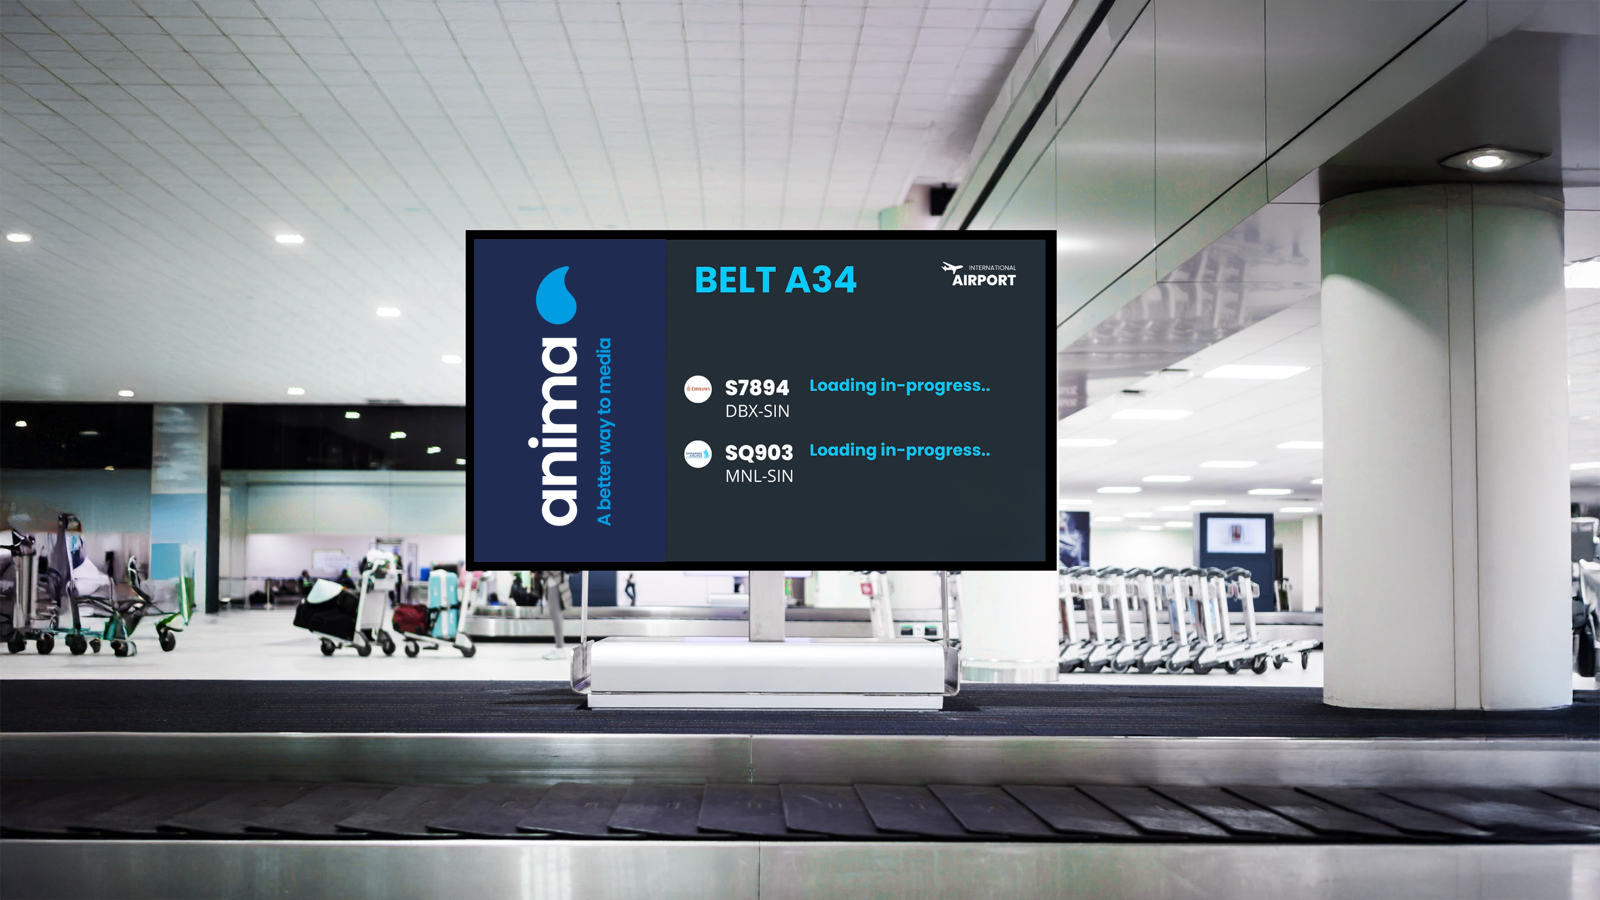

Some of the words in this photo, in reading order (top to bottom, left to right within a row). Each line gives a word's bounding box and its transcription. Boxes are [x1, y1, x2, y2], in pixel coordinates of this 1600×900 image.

[695, 266, 776, 294] BELT
[784, 265, 858, 294] A34
[952, 274, 1017, 286] AIRPORT
[595, 337, 612, 394] media
[724, 378, 790, 397] S7894
[809, 377, 877, 397] Loading
[880, 377, 991, 397] in-progress..
[597, 396, 612, 416] to
[725, 403, 790, 418] DBX-SIN
[527, 337, 578, 527] anima
[599, 417, 616, 456] way
[724, 443, 794, 464] SQ903
[809, 441, 877, 461] Loading
[880, 441, 991, 461] in-progress..
[596, 457, 612, 510] better
[725, 468, 794, 483] MNL-SIN
[597, 513, 612, 526] A
